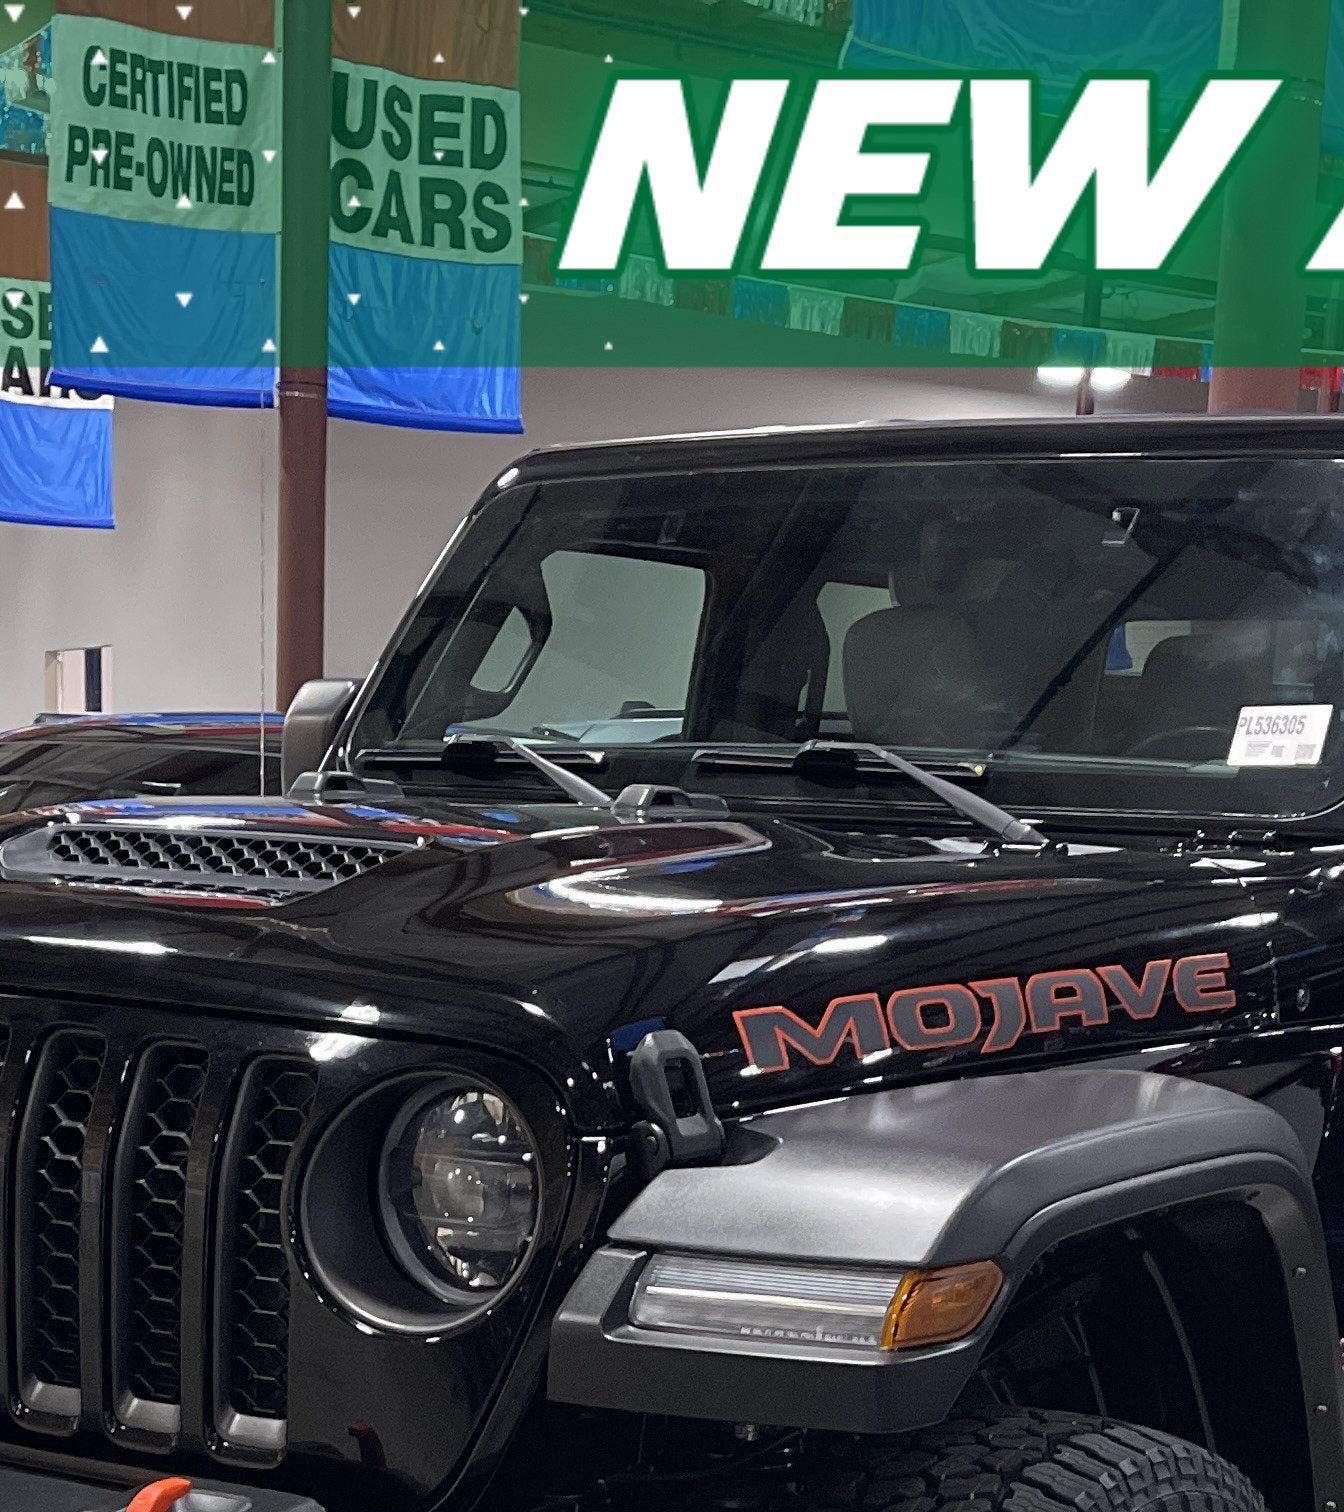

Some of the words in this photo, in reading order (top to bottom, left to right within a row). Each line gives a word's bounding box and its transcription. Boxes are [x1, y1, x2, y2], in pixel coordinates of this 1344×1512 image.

[83, 45, 248, 125] CERTIFIED
[331, 71, 507, 171] USED
[65, 124, 255, 207] PRE-OWNED
[331, 158, 512, 253] CARS
[732, 952, 1237, 1074] MOJAVE
